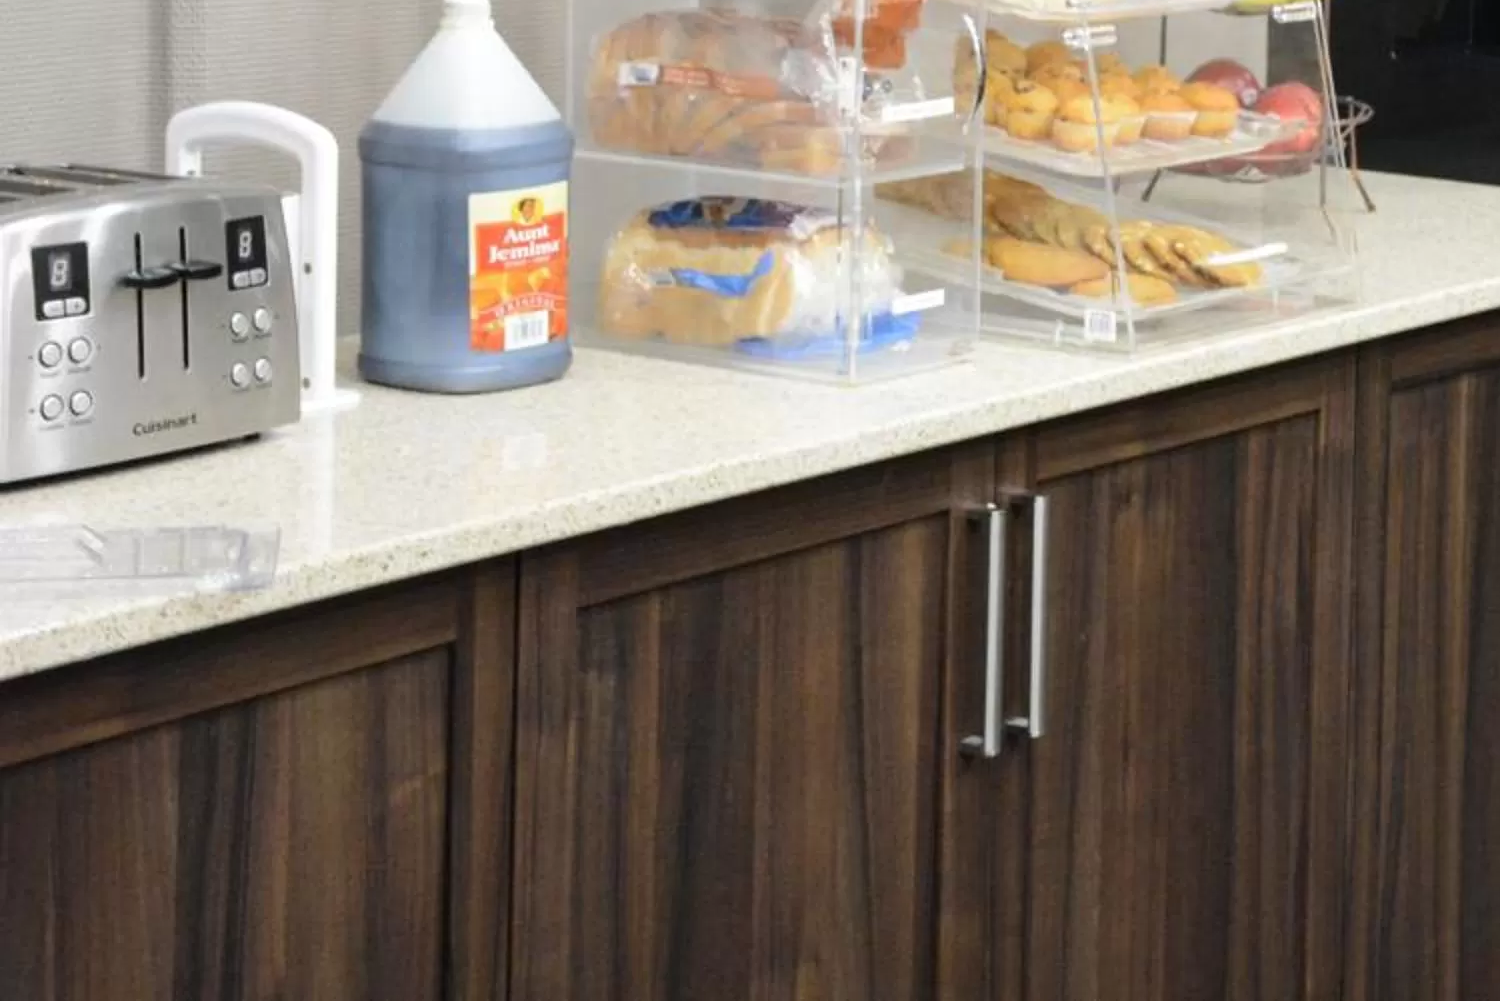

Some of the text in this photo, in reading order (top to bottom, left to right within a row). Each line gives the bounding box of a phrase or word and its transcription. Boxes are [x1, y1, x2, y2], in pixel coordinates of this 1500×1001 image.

[503, 224, 549, 244] Aunt
[488, 240, 561, 264] Jemima
[131, 411, 197, 437] Cuisinart
